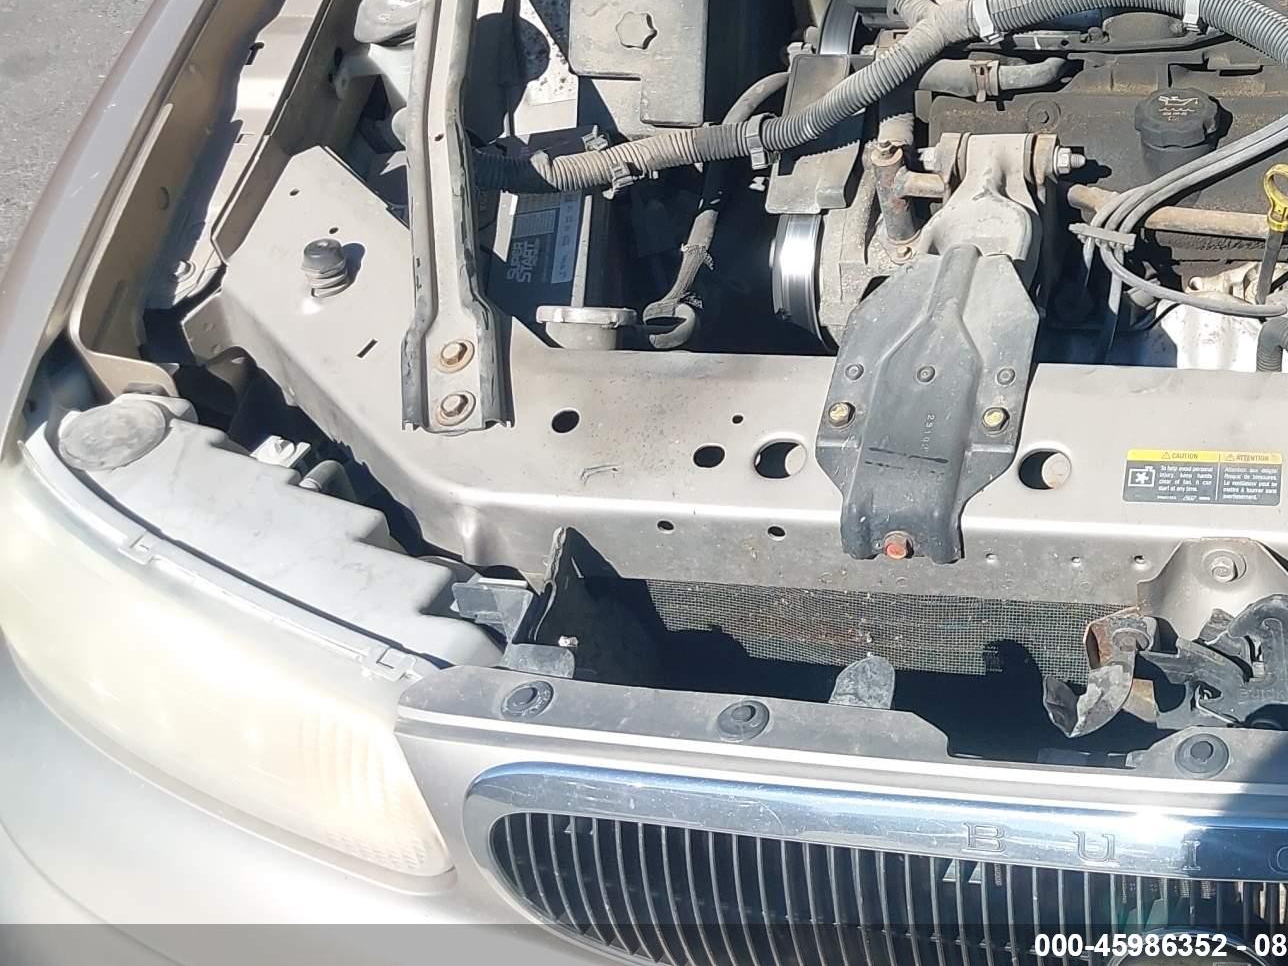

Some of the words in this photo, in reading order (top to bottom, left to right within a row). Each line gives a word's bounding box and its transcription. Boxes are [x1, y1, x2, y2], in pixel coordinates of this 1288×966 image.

[507, 241, 524, 280] SUPER
[516, 240, 532, 283] START
[1171, 452, 1199, 460] CAUTION
